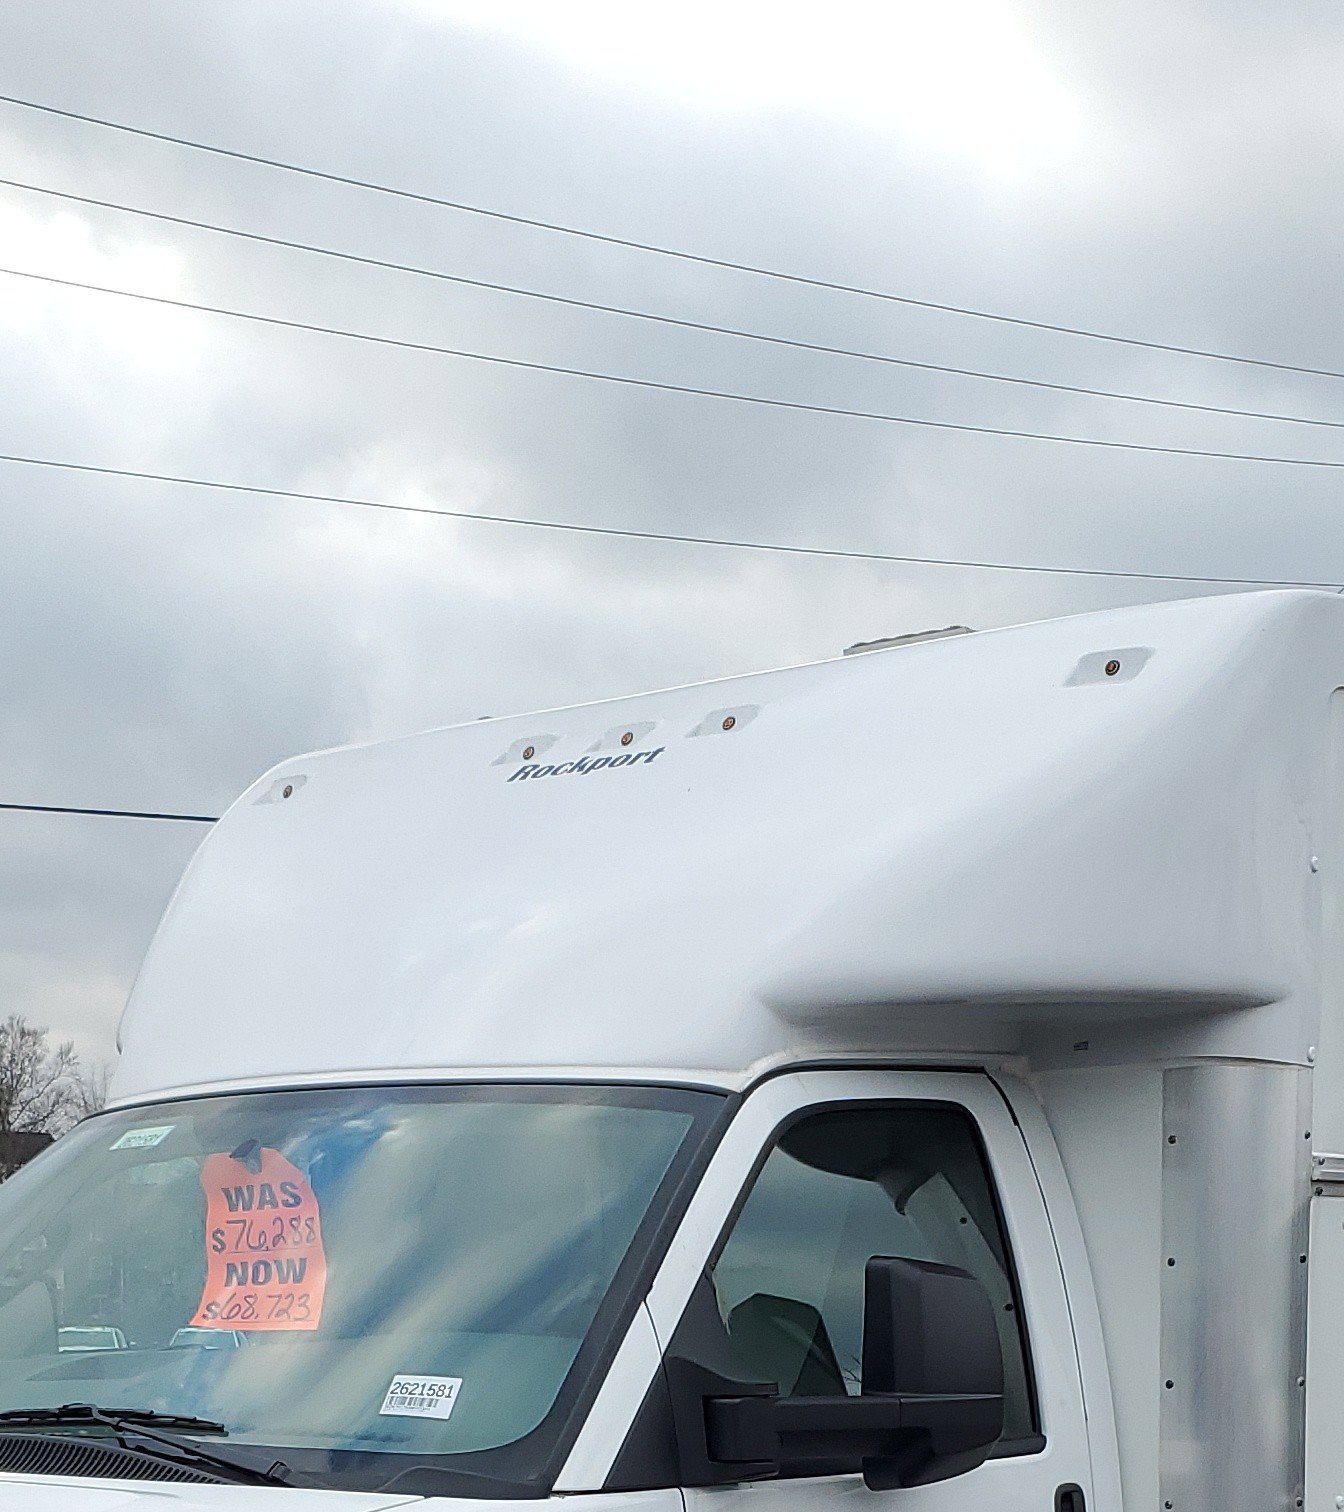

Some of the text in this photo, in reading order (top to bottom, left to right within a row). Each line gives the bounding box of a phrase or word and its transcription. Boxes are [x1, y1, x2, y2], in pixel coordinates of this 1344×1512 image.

[506, 746, 666, 783] Rockport
[221, 1181, 302, 1212] WAS
[224, 1257, 308, 1287] NOW
[389, 1381, 454, 1399] 2621581
